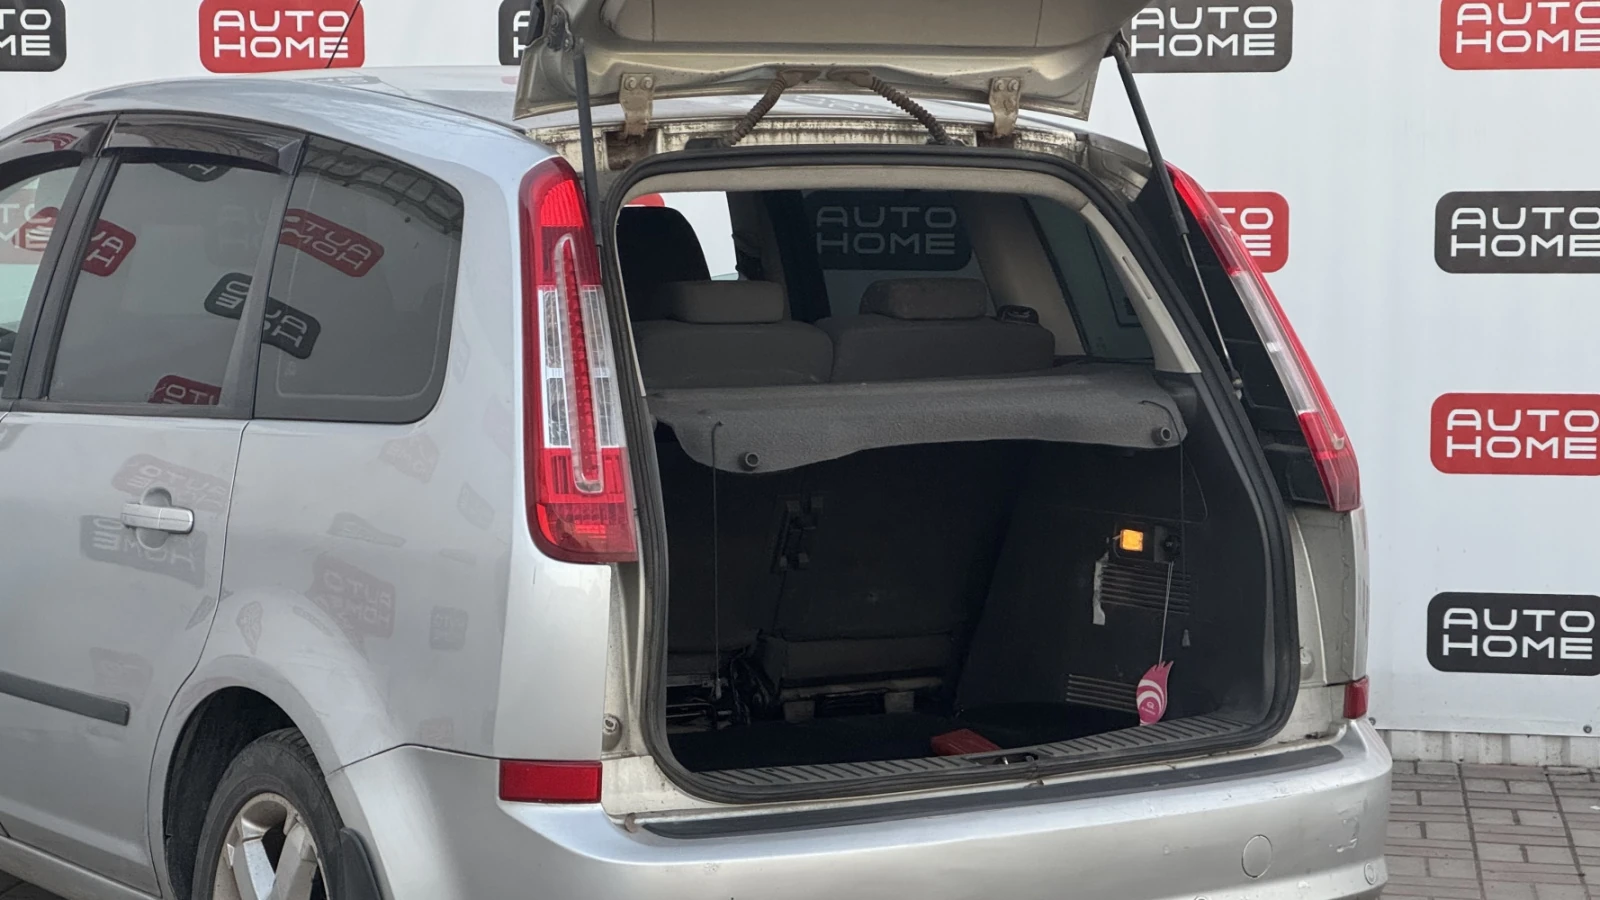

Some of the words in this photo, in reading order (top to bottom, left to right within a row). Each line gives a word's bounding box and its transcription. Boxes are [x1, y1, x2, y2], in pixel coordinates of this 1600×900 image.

[213, 10, 349, 32] AUTO
[1131, 6, 1277, 30] AUTO
[1457, 1, 1600, 26] AUTO
[213, 36, 349, 58] HOME
[1130, 33, 1275, 57] HOME
[1456, 29, 1600, 53] HOME
[816, 206, 957, 228] AUTO
[1451, 207, 1600, 230] AUTO
[816, 232, 955, 254] HOME
[1450, 234, 1600, 257] HOME
[1447, 408, 1600, 432] AUTO
[1446, 436, 1597, 459] HOME
[1443, 607, 1596, 633] AUTO
[1442, 634, 1593, 660] HOME
